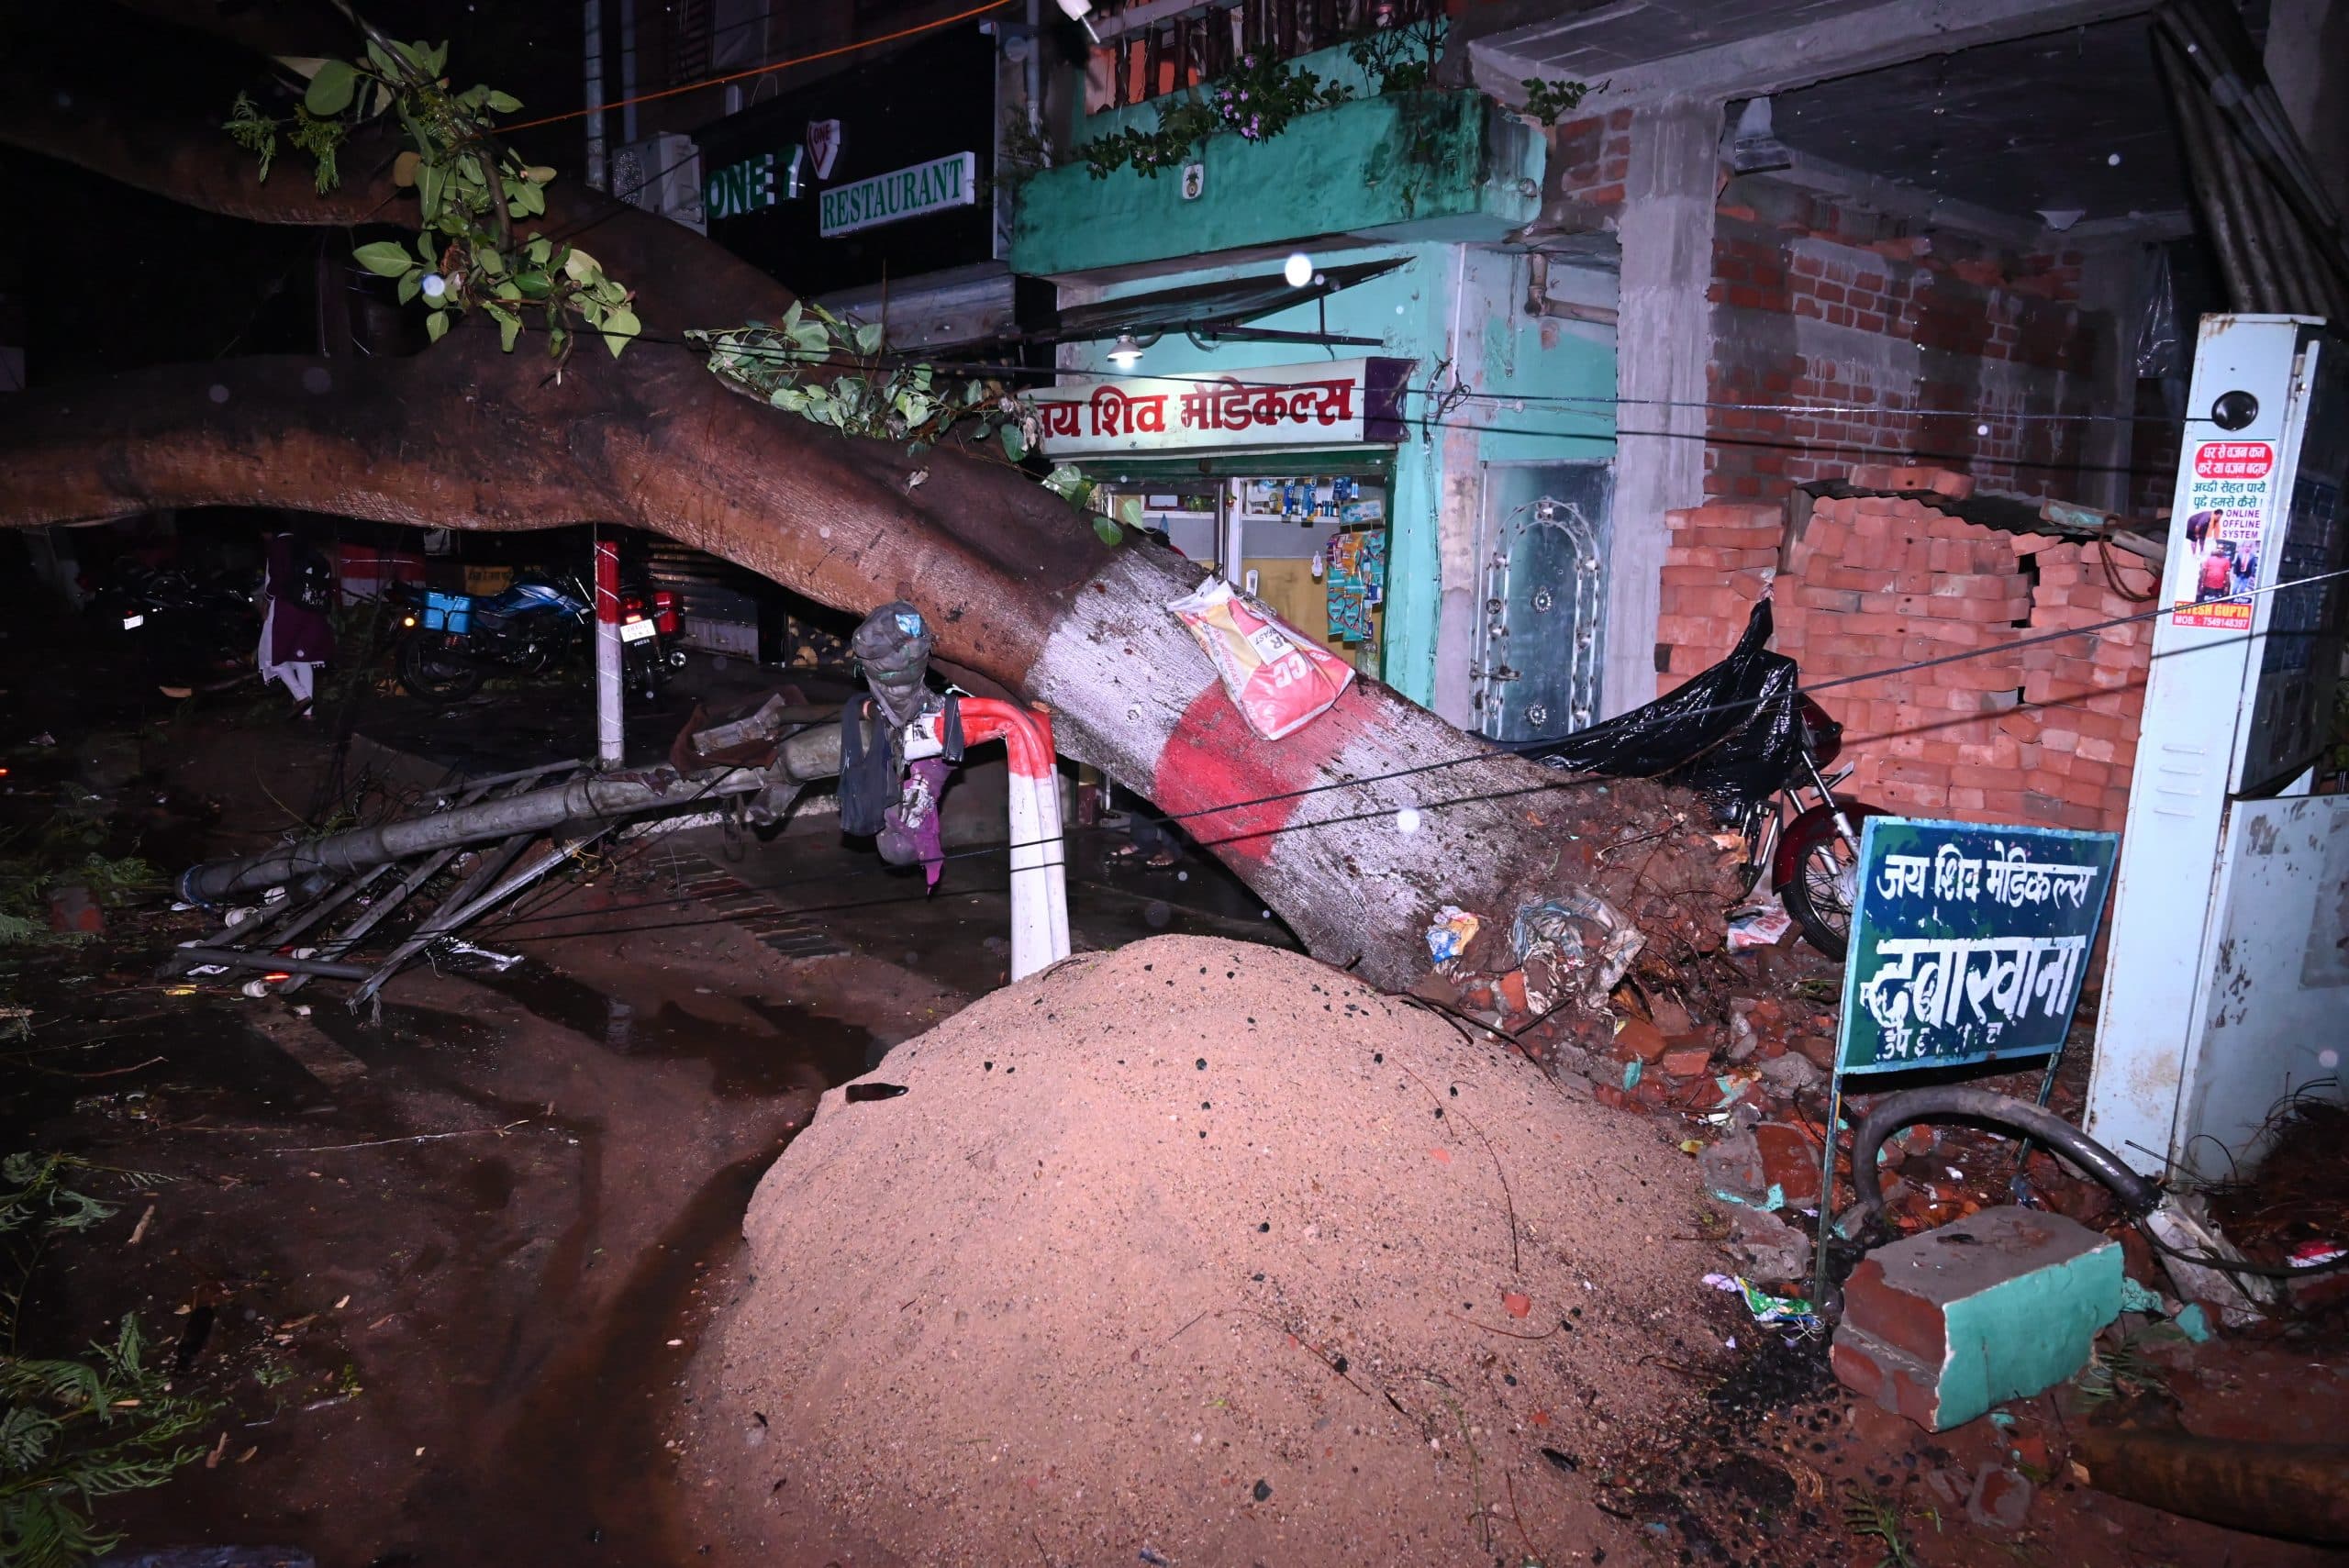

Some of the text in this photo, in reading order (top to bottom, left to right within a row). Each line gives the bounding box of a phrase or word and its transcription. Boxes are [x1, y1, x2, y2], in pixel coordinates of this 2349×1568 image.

[705, 153, 774, 218] ONE
[821, 157, 964, 229] RESTAURANT
[1089, 385, 1169, 438] शिव
[1180, 376, 1356, 430] मेडिकल्स
[2203, 444, 2266, 459] घर से वजन कम
[2213, 462, 2224, 473] या
[2224, 462, 2245, 474] वजन
[2221, 481, 2244, 493] सेहत
[2210, 495, 2236, 507] हमसे
[2226, 509, 2260, 518] ONLINE
[2222, 519, 2261, 528] OFFLINE
[2221, 530, 2258, 539] SYSTEM
[2214, 603, 2250, 617] GUPTA
[1273, 651, 1315, 688] CC
[1876, 840, 2099, 909] जय शिव मेडिकल्स
[1860, 936, 2086, 1029] दवाखाना
